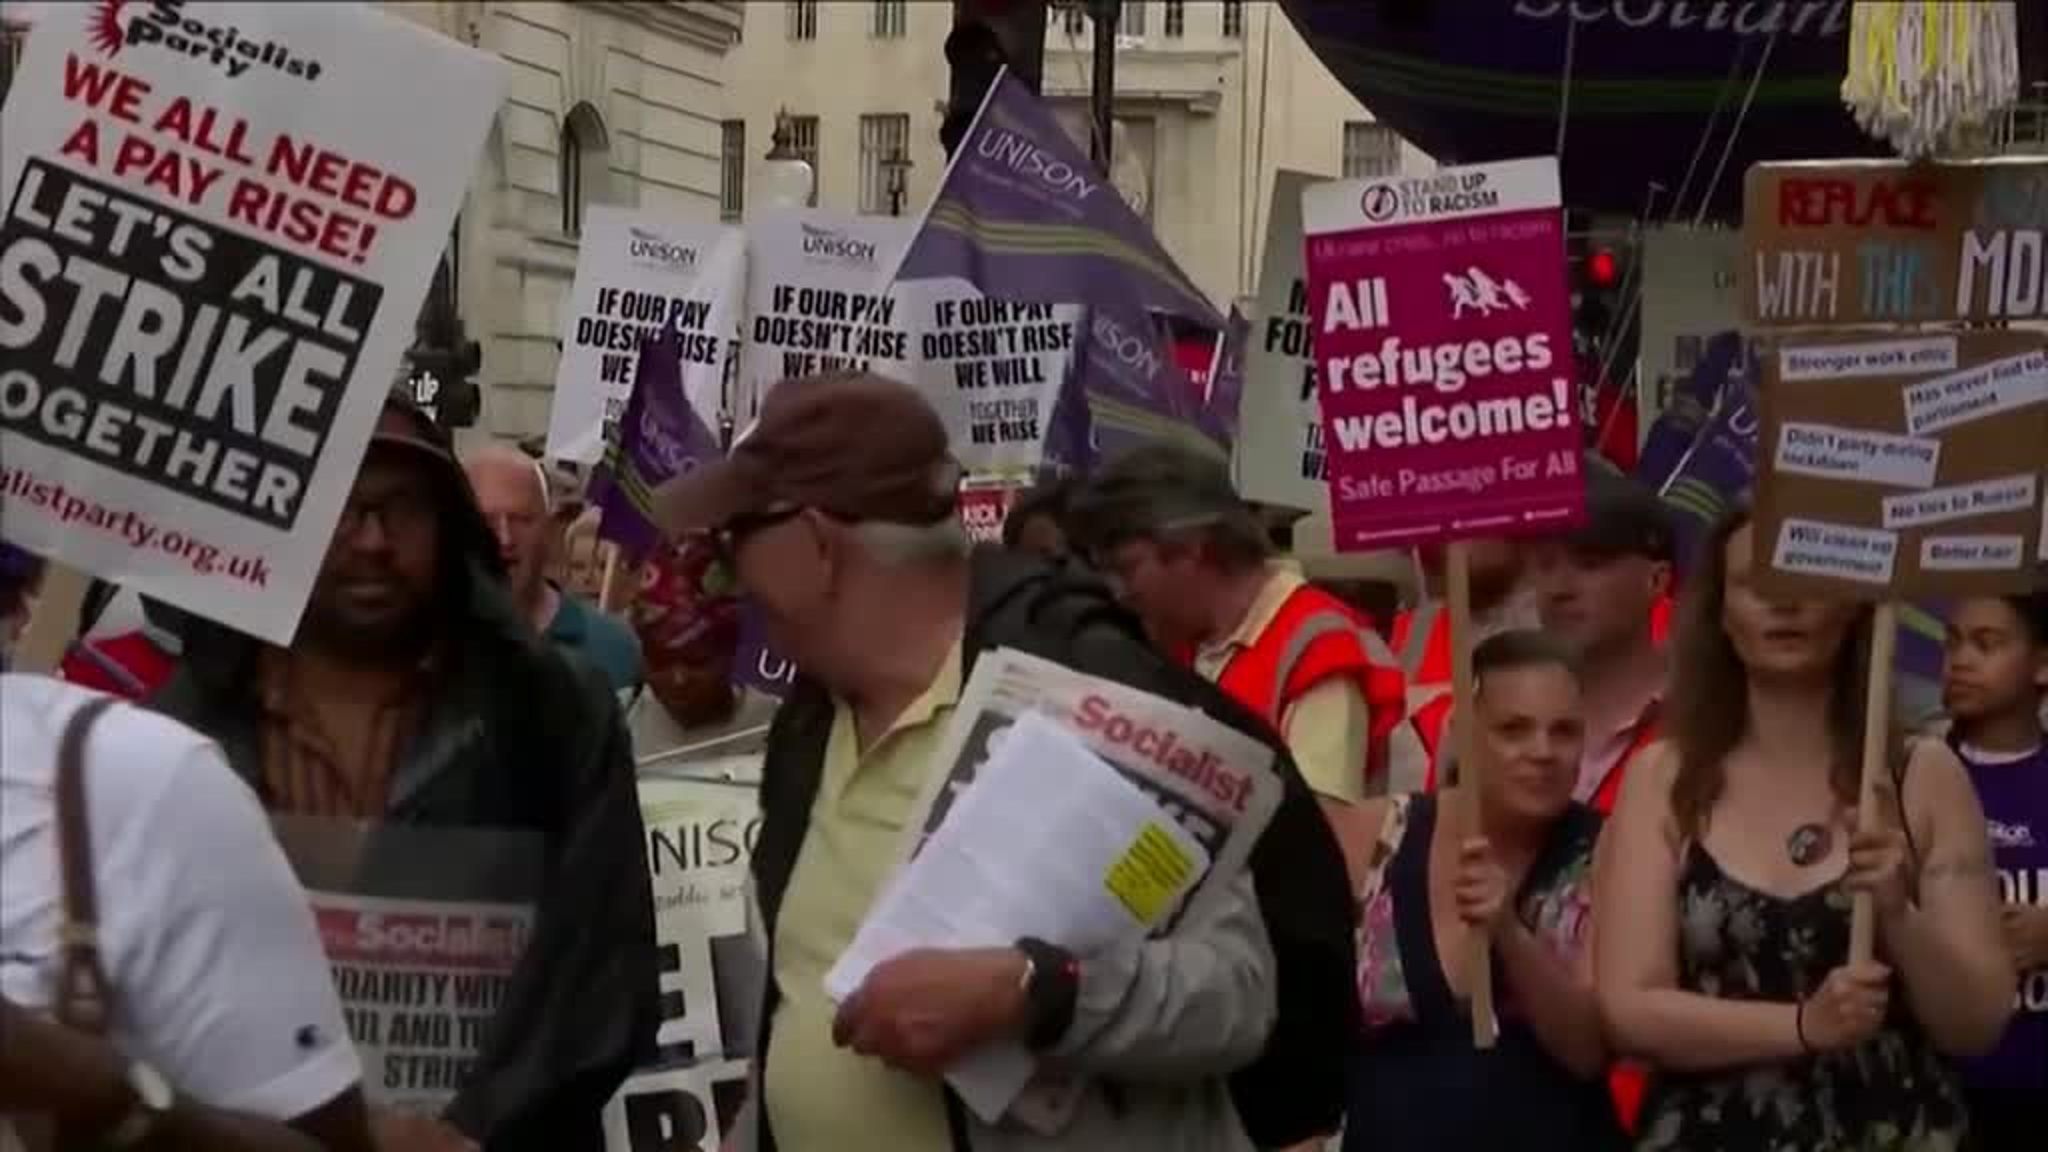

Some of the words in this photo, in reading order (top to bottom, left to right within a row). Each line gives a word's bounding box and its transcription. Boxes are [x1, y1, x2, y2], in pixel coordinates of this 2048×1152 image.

[125, 17, 251, 78] Party
[147, 1, 322, 81] Socialist
[64, 52, 151, 125] WE
[155, 97, 253, 166] ALL
[267, 134, 417, 221] NEED
[978, 128, 1099, 199] UNISON
[61, 120, 99, 166] A
[114, 134, 225, 204] PAY
[227, 180, 377, 265] RISE!
[1400, 177, 1459, 198] STAND
[1461, 173, 1487, 192] UP
[1402, 196, 1427, 216] TO
[1429, 190, 1499, 213] RACISM
[14, 168, 214, 283] LET'S
[230, 255, 360, 343] ALL
[630, 240, 698, 264] UNISON
[803, 237, 876, 262] UNISON
[1756, 251, 1841, 318] WITH
[1956, 229, 2048, 318] MO
[597, 286, 619, 315] IF
[620, 290, 667, 324] OUR
[668, 297, 711, 332] PAY
[773, 283, 796, 314] IF
[799, 286, 850, 321] OUR
[850, 293, 896, 326] PAY
[935, 301, 956, 329] IF
[960, 298, 1009, 327] OUR
[1012, 302, 1054, 324] PAY
[1324, 276, 1390, 334] All
[0, 237, 349, 459] STRIKE
[753, 316, 853, 355] DOESN'T
[922, 325, 1018, 361] DOESN'T
[1022, 321, 1074, 353] RISE
[601, 353, 632, 385] WE
[955, 360, 990, 390] WE
[991, 357, 1047, 386] WILL
[1327, 332, 1553, 393] refugees
[1789, 351, 1860, 373] Stronger
[1865, 349, 1907, 366] work
[1910, 386, 1942, 405] Has
[1944, 373, 1990, 396] never
[999, 418, 1040, 443] RISE
[1333, 378, 1571, 452] welcome!
[0, 371, 302, 518] OGETHER
[1787, 428, 1834, 448] Didn't
[1837, 436, 1877, 457] party
[1885, 443, 1934, 463] during
[1338, 474, 1393, 501] Safe
[1399, 463, 1496, 496] Passage
[1502, 455, 1540, 481] For
[1546, 451, 1577, 477] All
[1891, 504, 1915, 519] No
[1952, 494, 1968, 510] to
[1790, 525, 1821, 543] Will
[1981, 542, 2016, 560] hair
[1073, 694, 1255, 812] Socialist
[650, 818, 766, 877] NIS
[331, 966, 449, 1005] DARITY
[388, 1012, 449, 1048] AND
